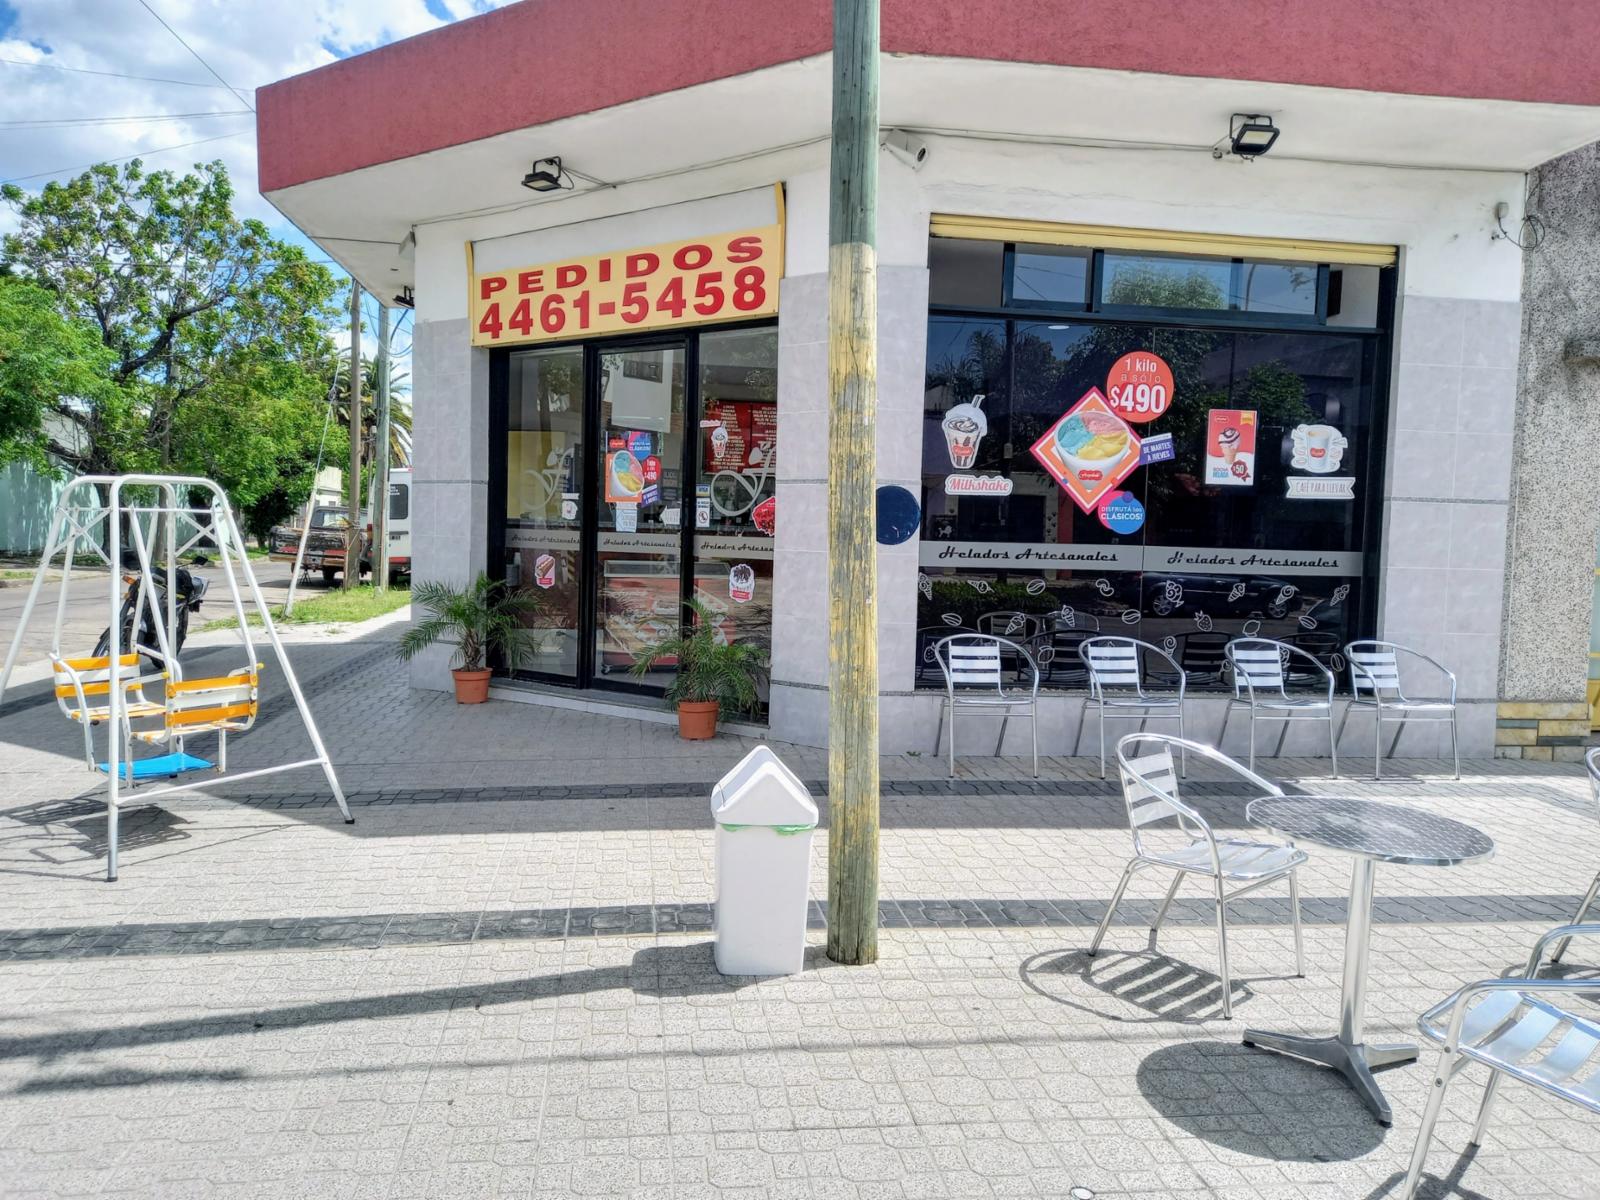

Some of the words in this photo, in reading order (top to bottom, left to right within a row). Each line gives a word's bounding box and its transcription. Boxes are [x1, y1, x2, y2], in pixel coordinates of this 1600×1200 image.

[480, 236, 763, 300] PEDIDOS
[479, 265, 767, 339] 4461-5458
[1126, 358, 1131, 371] 1
[1136, 359, 1157, 373] kilo
[1110, 383, 1166, 414] $490
[950, 477, 1010, 491] Milkshake
[938, 545, 1010, 560] Helados
[1014, 548, 1119, 562] Artesanales
[1167, 551, 1236, 565] Helados
[1240, 554, 1340, 568] Artesanales
